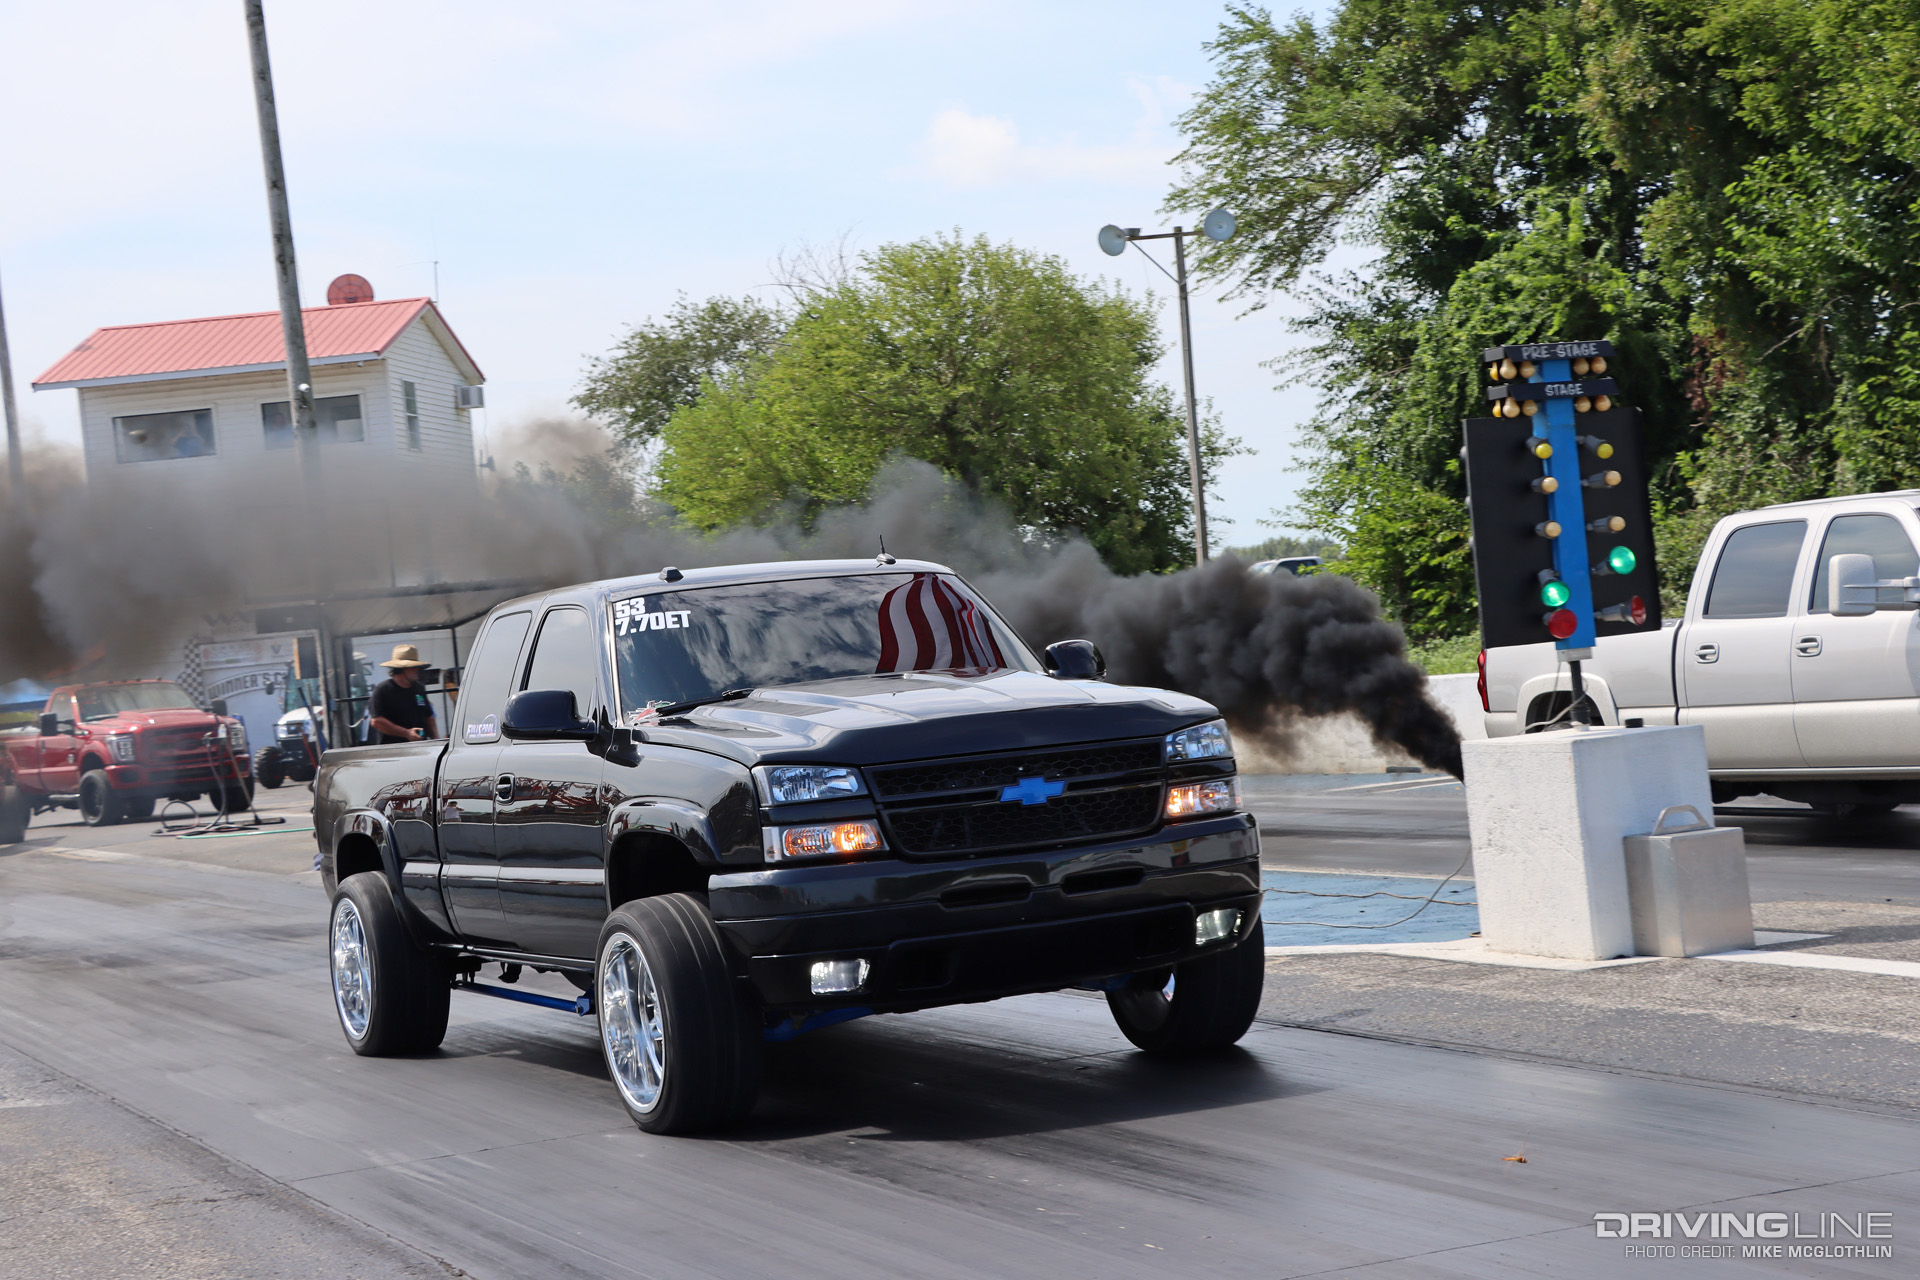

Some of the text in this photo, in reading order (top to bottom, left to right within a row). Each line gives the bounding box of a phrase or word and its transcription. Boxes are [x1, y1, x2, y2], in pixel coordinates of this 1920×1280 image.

[1521, 343, 1599, 360] PRE-STAGE
[1545, 383, 1584, 397] STAGE
[615, 597, 646, 618] 53
[615, 610, 692, 636] 7.70ET
